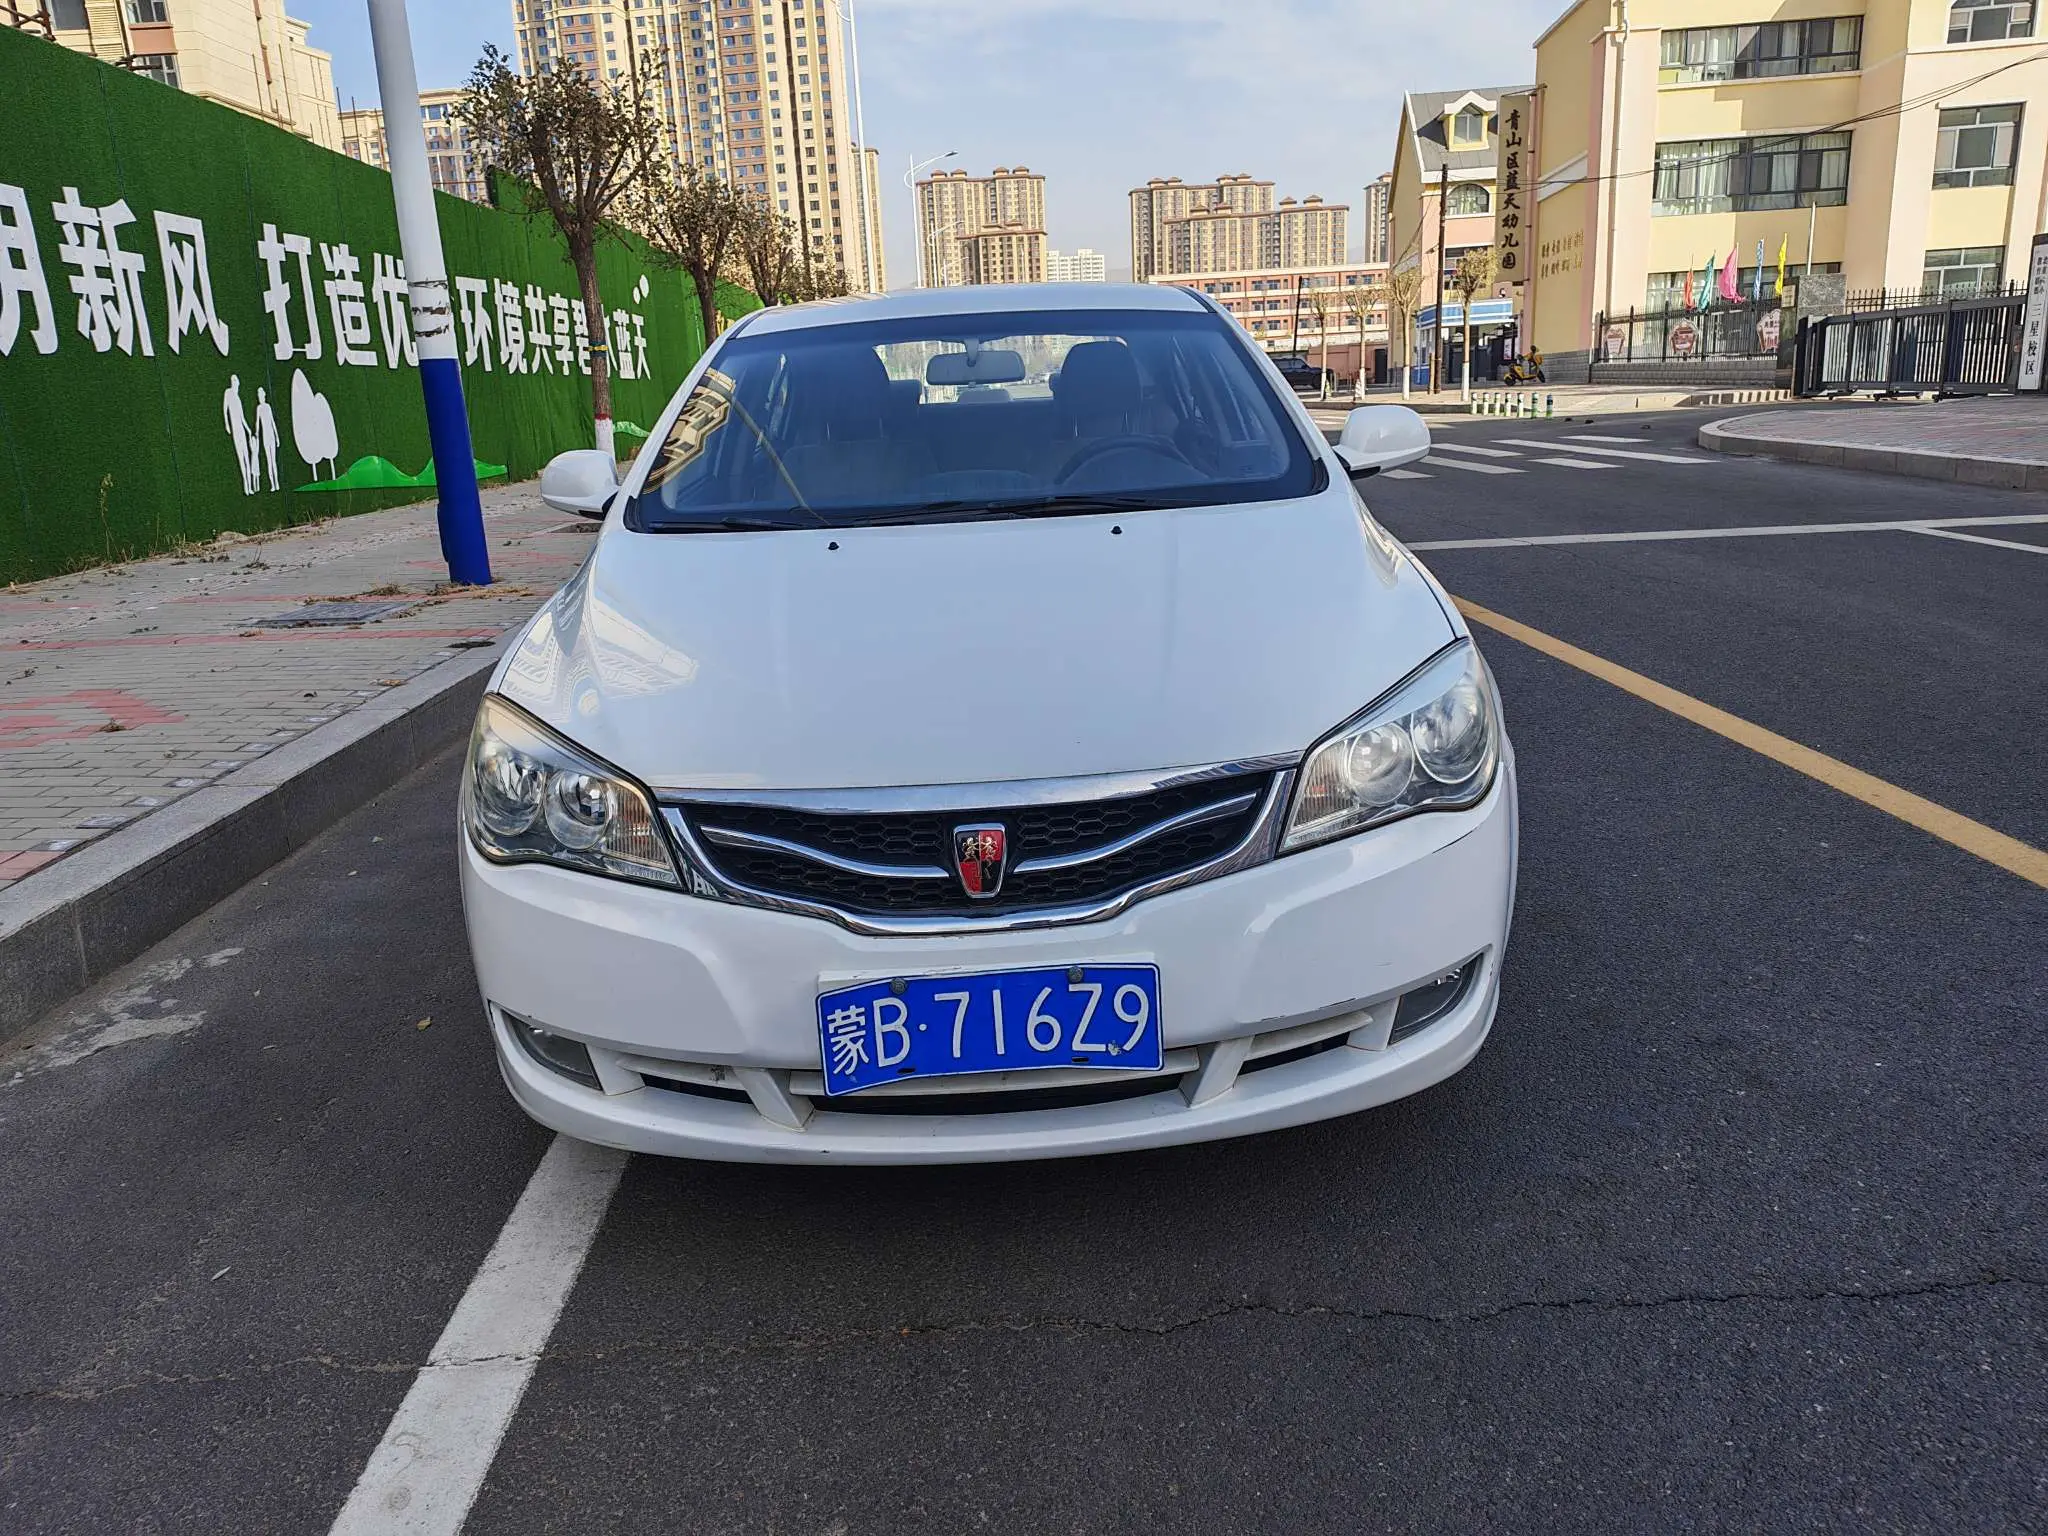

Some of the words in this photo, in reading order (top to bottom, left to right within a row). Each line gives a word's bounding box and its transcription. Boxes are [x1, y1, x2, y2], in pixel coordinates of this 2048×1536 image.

[1501, 109, 1522, 269] 青山区蓝天幼儿园
[257, 223, 651, 380] 打造优环境共享碧水蓝天
[2025, 303, 2042, 375] 三星校区
[826, 984, 1149, 1076] 蒙B·716Z9
